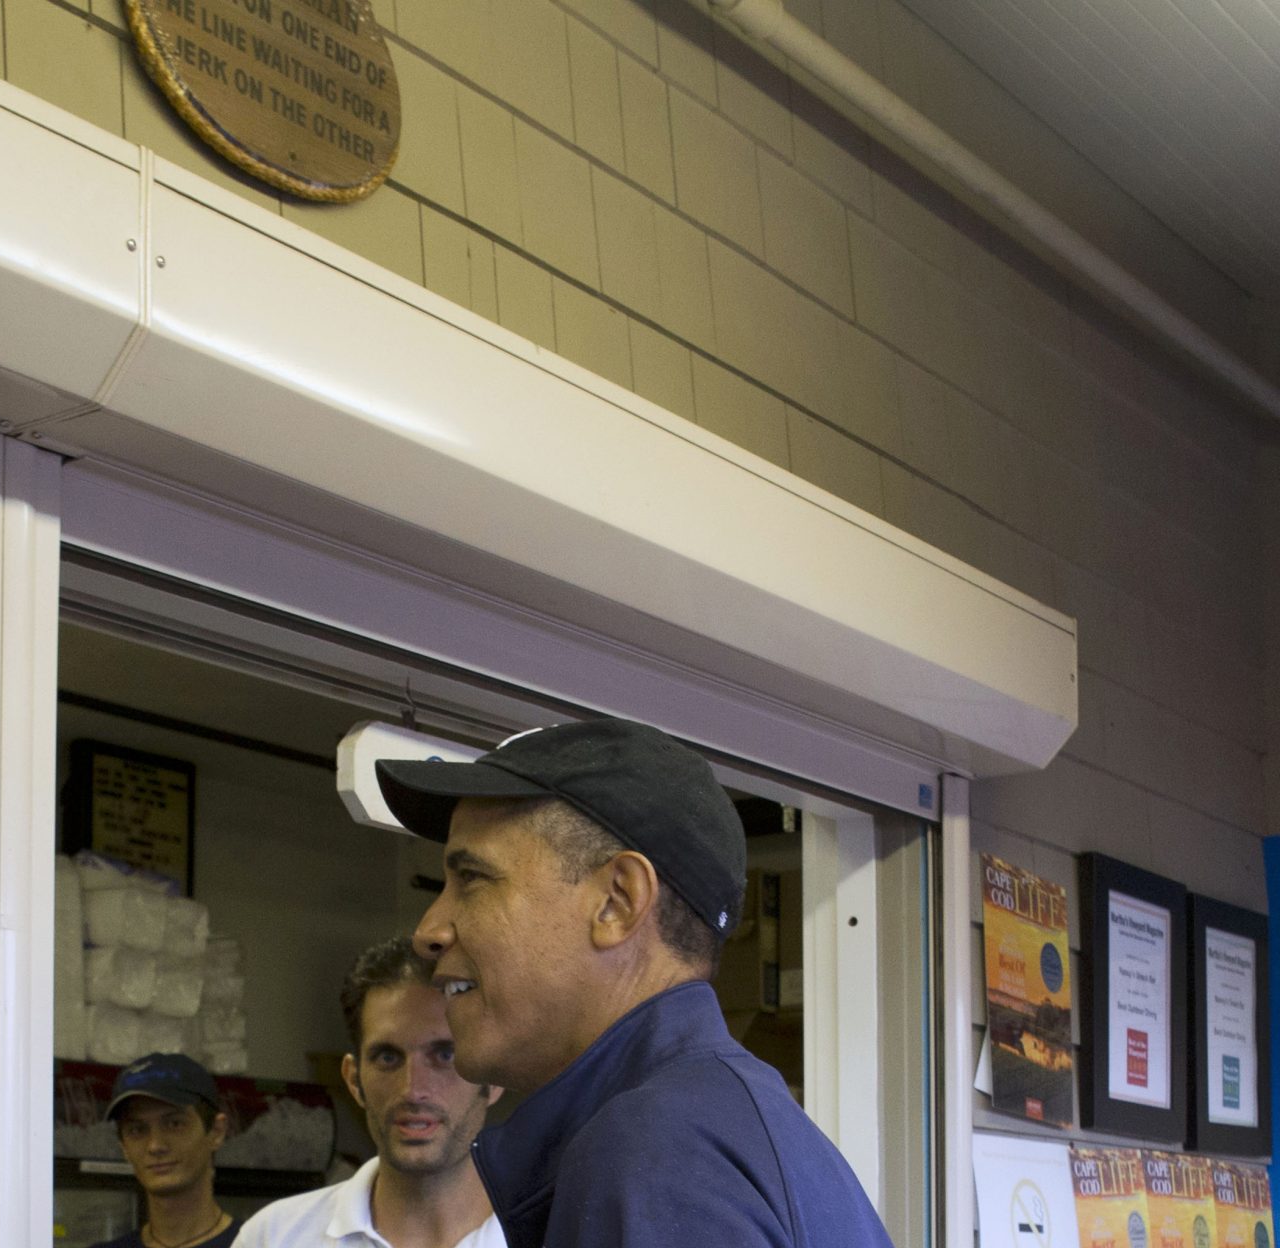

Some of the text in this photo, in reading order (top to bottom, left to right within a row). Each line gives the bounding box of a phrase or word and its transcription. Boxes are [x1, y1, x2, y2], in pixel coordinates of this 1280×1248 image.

[282, 8, 319, 50] ONE
[323, 35, 362, 74] END
[365, 59, 387, 90] OF
[201, 7, 247, 52] LINE
[252, 35, 338, 104] WAITING
[342, 87, 375, 127] FOR
[379, 110, 391, 135] A
[175, 35, 375, 164] JERK ON THE OTHER
[991, 887, 1014, 911] COD
[1080, 1179, 1101, 1195] COD
[1096, 1160, 1137, 1196] LIFE
[1151, 1178, 1172, 1195] COD
[1169, 1163, 1206, 1199] LIFE
